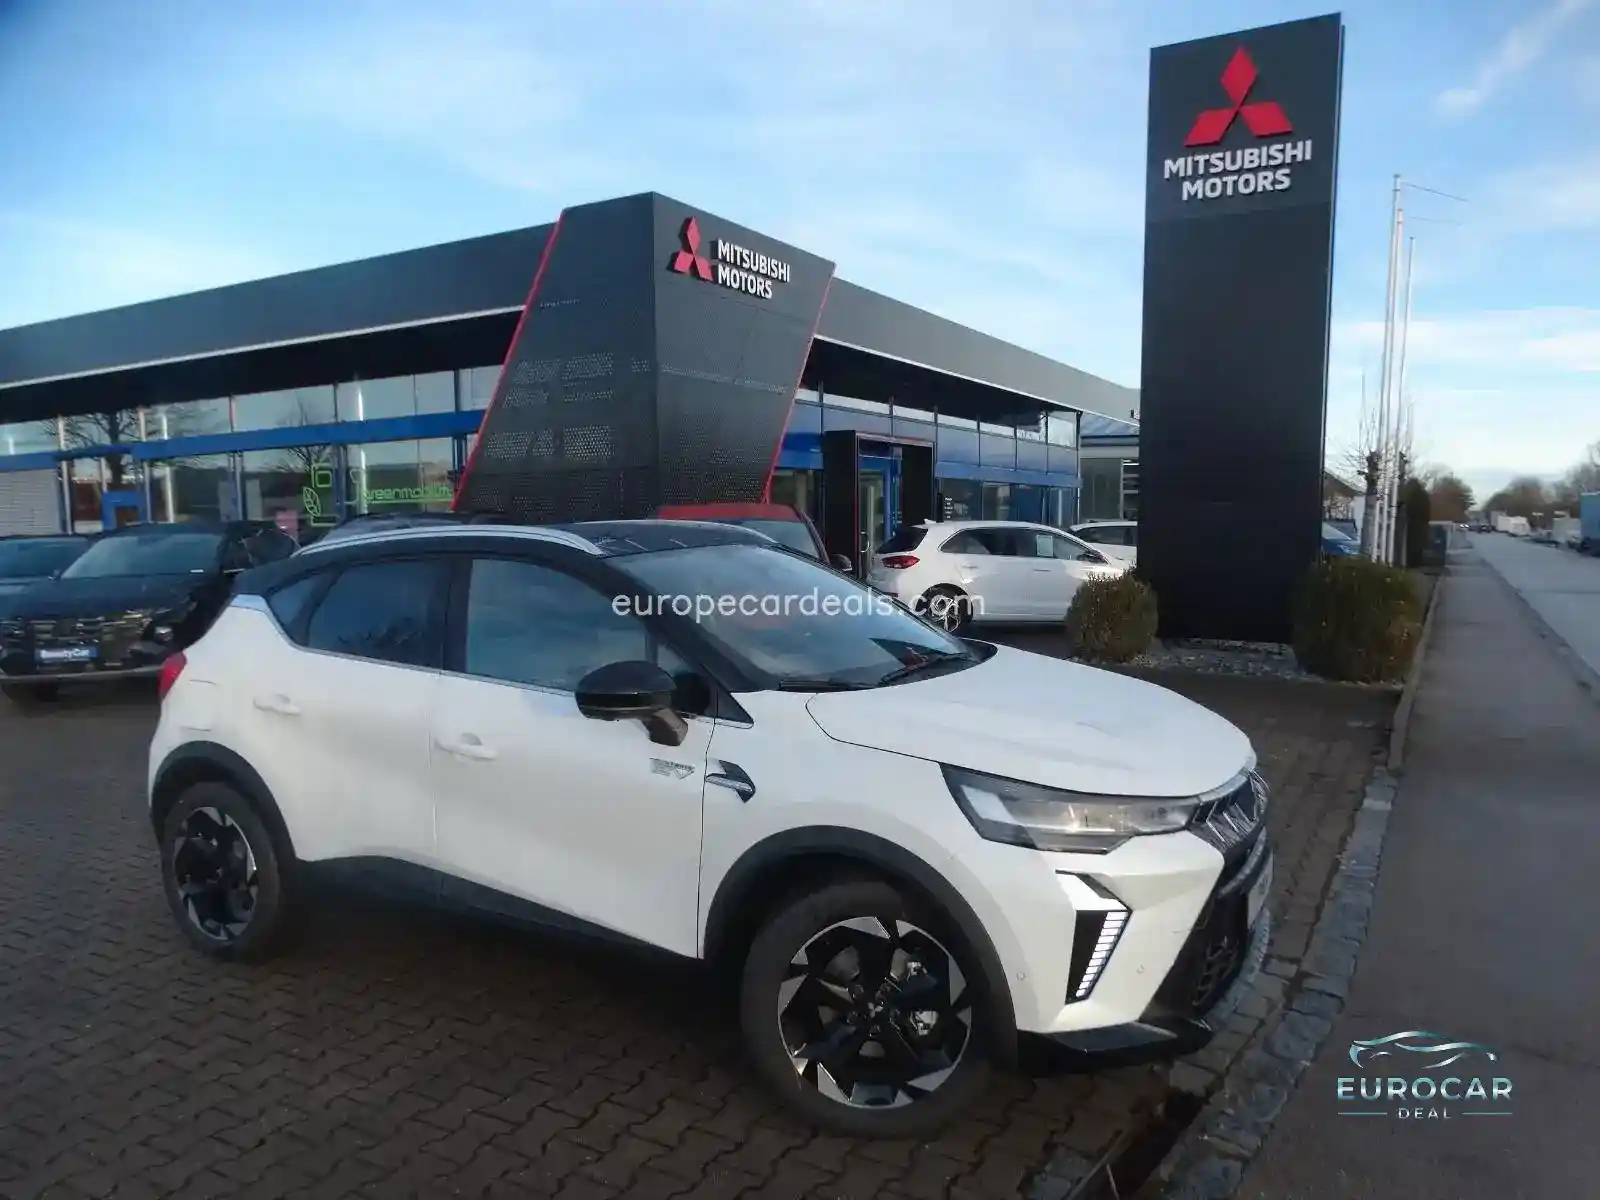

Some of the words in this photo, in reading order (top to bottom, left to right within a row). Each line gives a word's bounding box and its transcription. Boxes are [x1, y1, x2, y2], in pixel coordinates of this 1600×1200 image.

[1164, 139, 1313, 179] MITSUBISHI
[1182, 168, 1291, 201] MOTORS
[717, 239, 790, 283] MITSUBISHI
[717, 264, 773, 299] MOTORS
